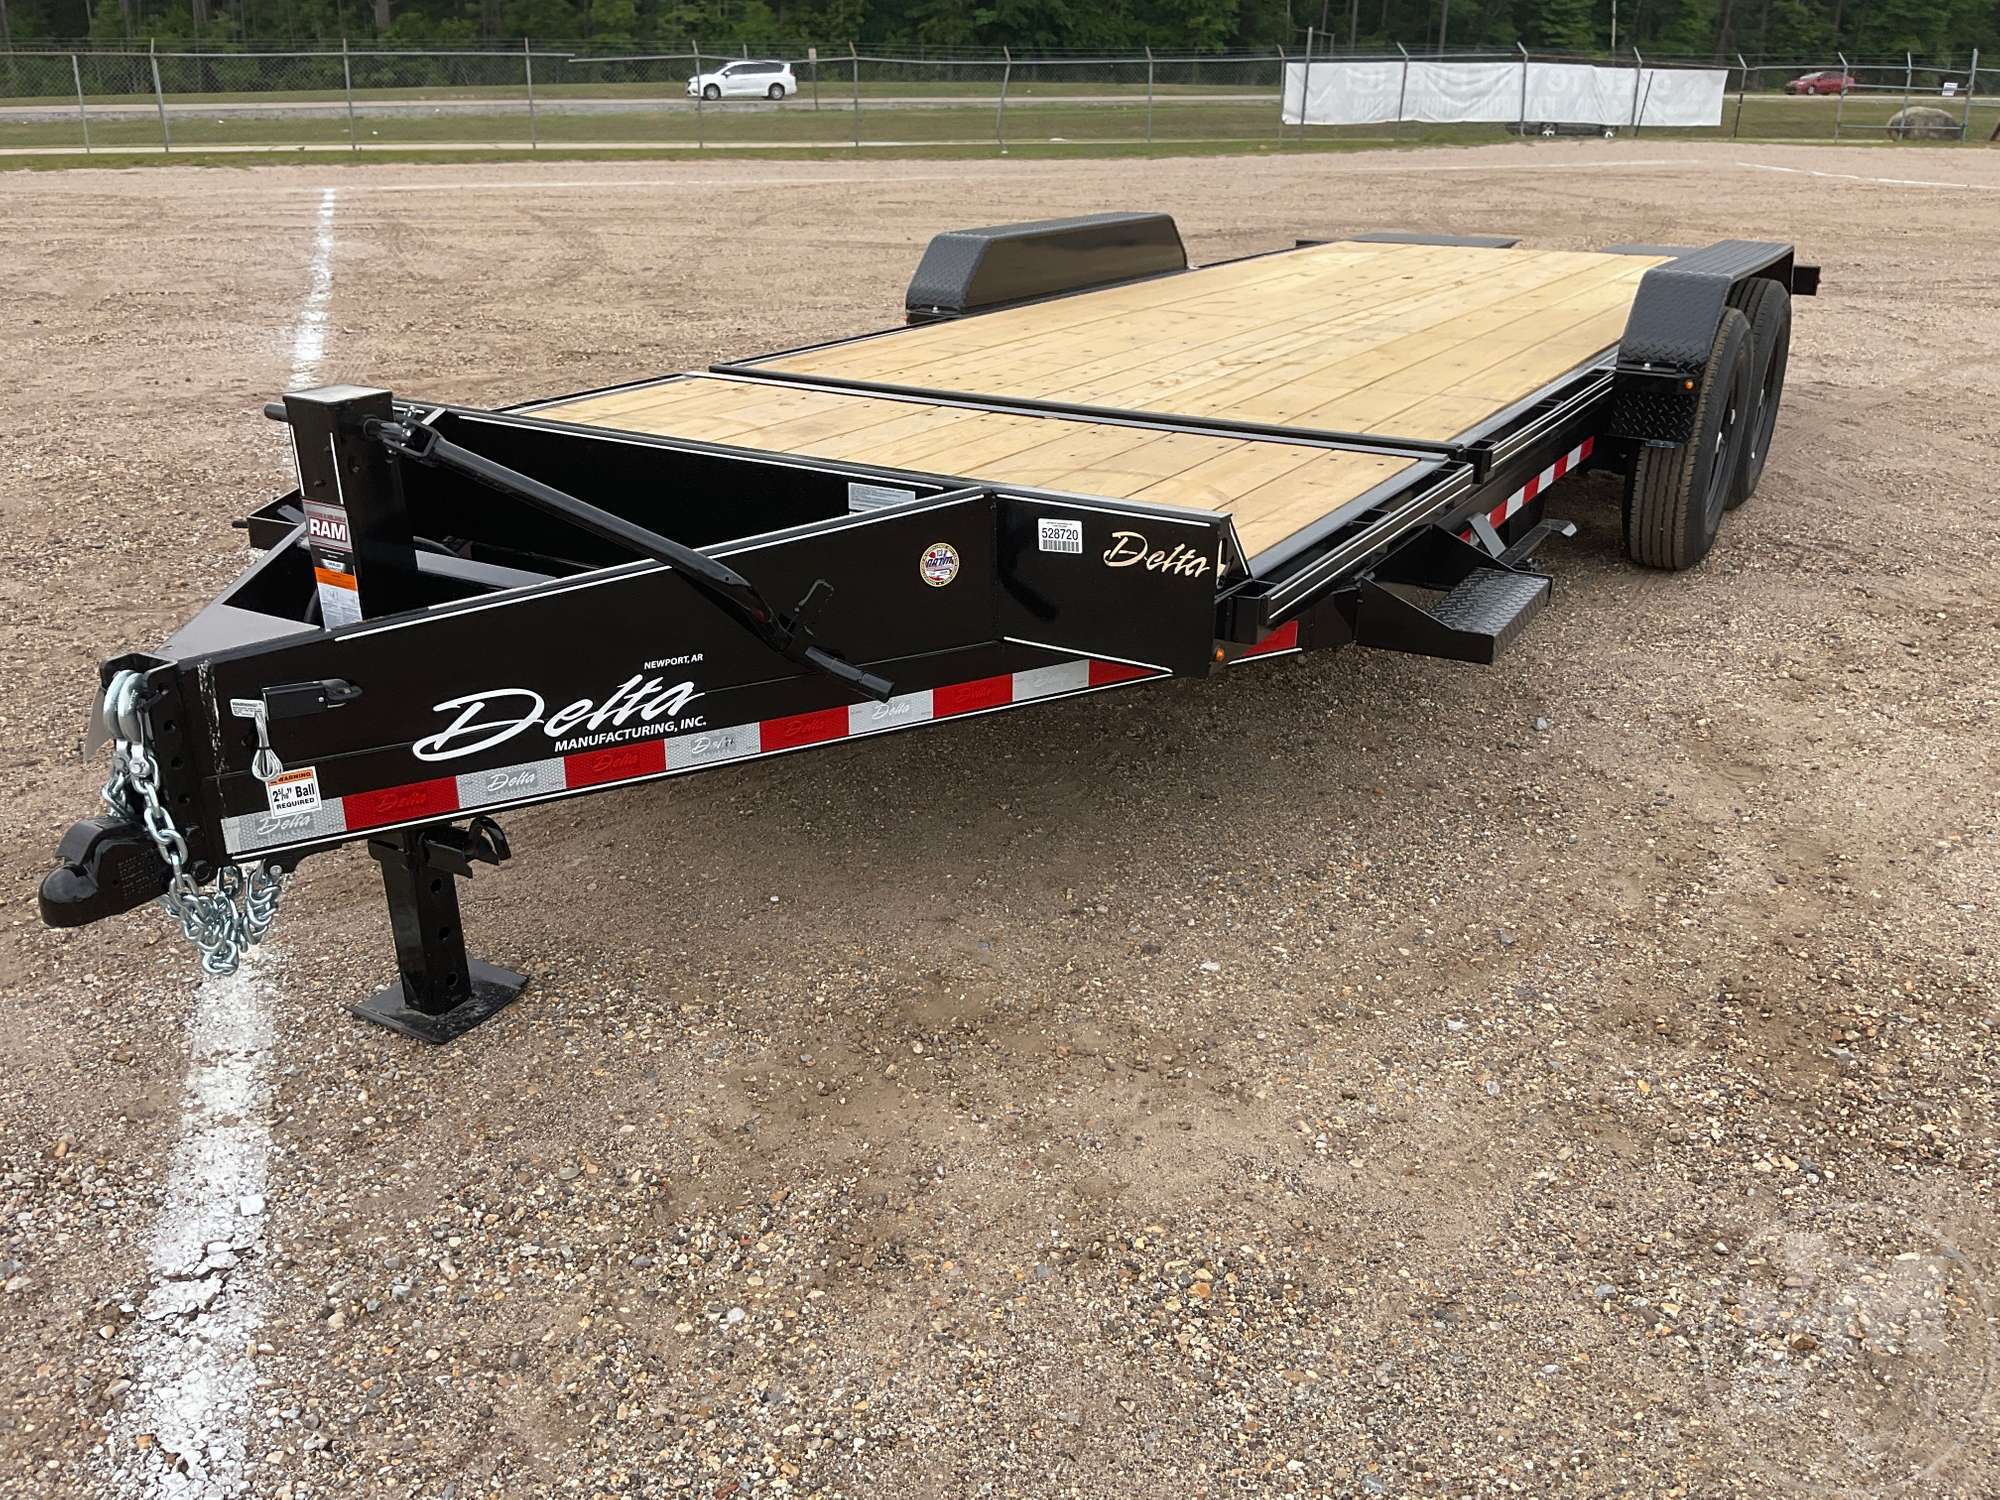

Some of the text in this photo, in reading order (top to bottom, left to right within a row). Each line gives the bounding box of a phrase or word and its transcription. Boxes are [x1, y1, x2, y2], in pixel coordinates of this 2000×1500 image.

[309, 518, 346, 541] RAM
[1041, 527, 1079, 541] 528720
[1102, 530, 1211, 578] Delta
[644, 653, 704, 670] NEWPORT, AR
[412, 673, 706, 762] Delta
[554, 715, 707, 752] MANUFACTURING, INC.
[295, 783, 315, 798] Ball
[488, 770, 535, 792] Delta
[276, 797, 315, 810] REQUIRED
